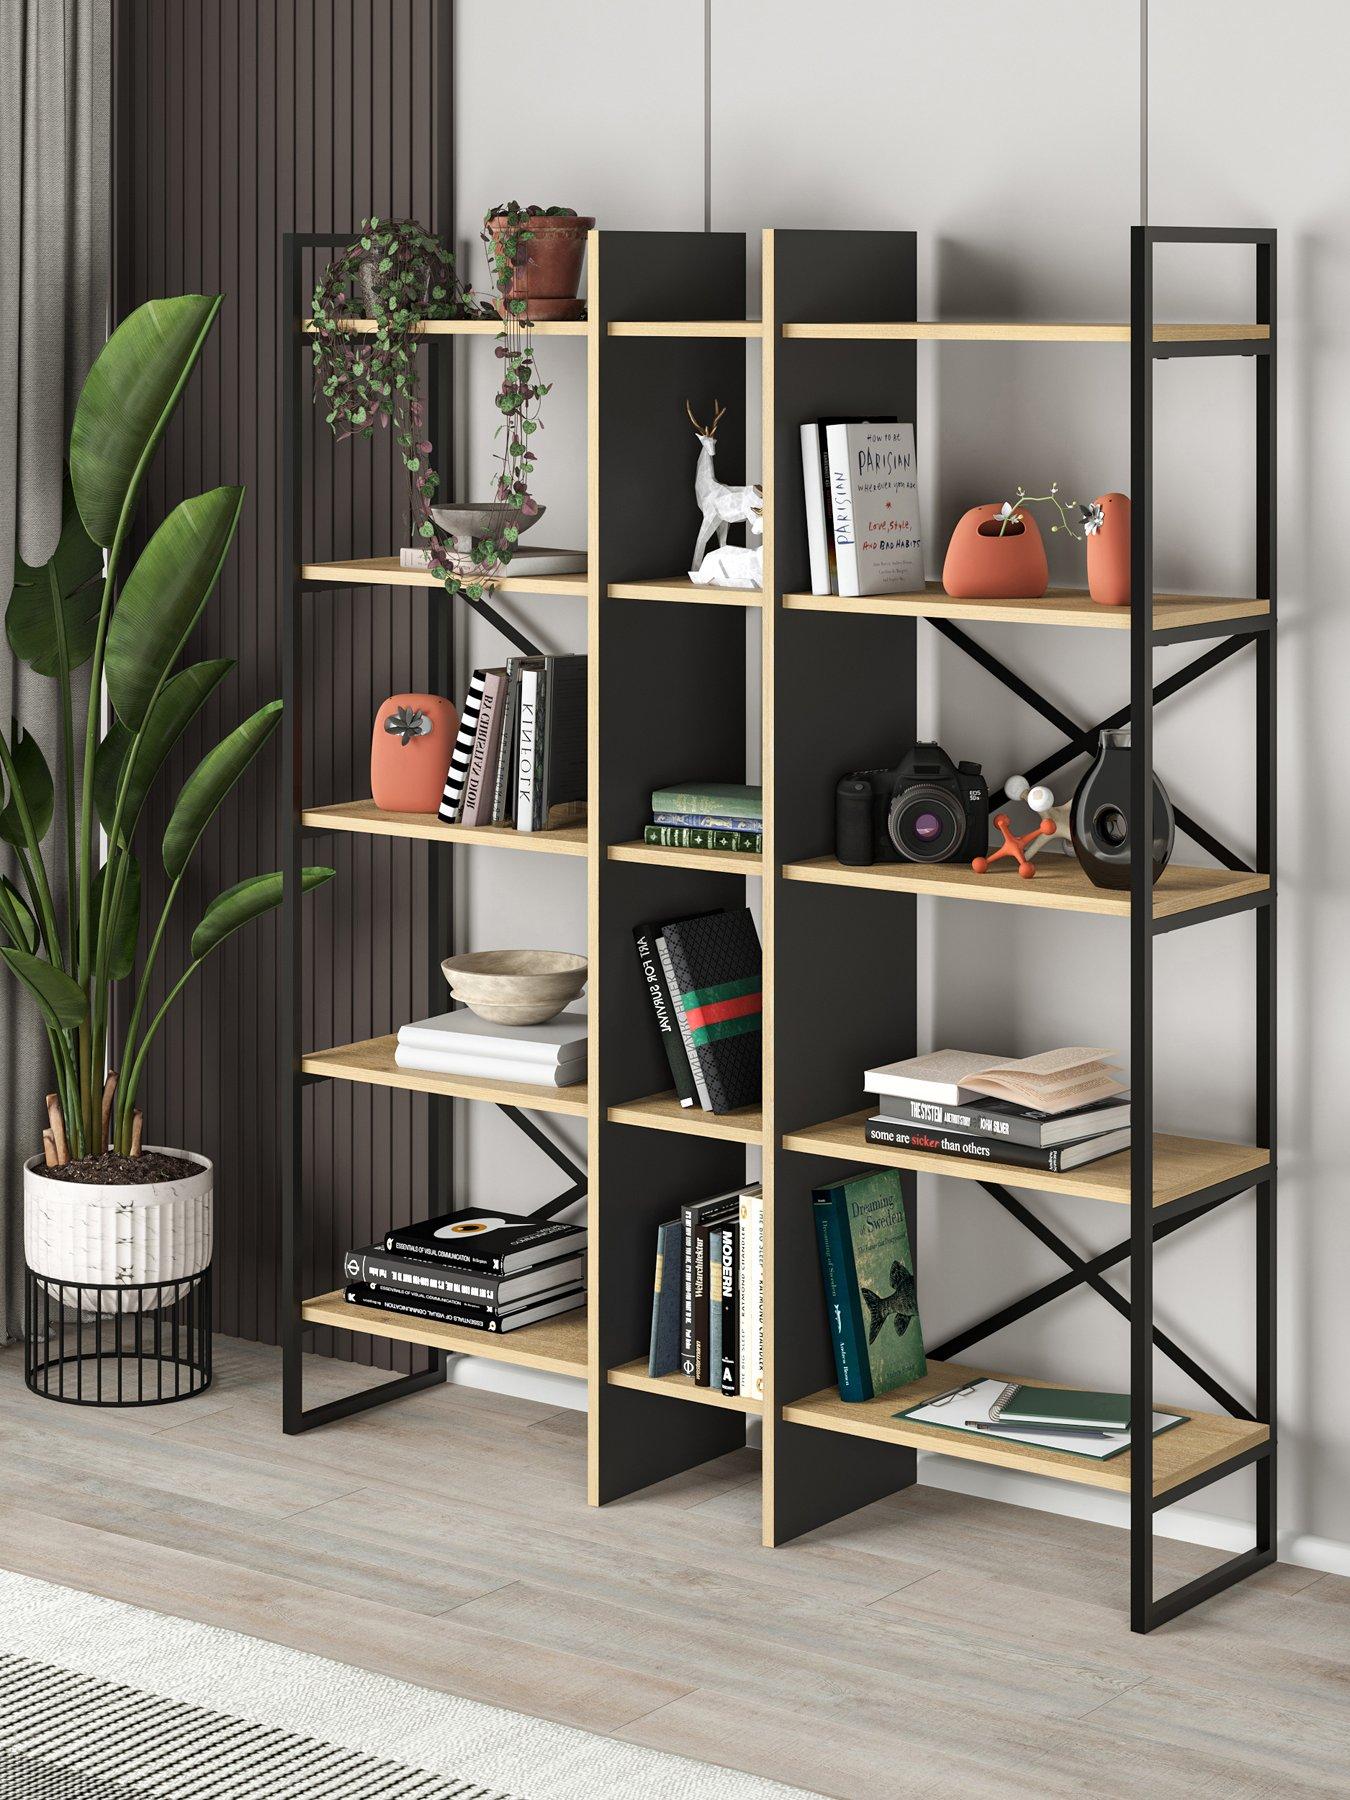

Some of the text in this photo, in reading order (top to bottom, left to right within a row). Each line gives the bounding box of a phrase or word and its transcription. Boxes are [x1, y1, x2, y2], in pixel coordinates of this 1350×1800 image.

[858, 446, 911, 476] PARISIAN
[835, 472, 854, 545] PARISIAN
[879, 540, 894, 550] BAD
[896, 539, 921, 549] HABITS
[910, 1101, 921, 1118] THE
[920, 1102, 943, 1123] SYSTEM
[980, 1117, 993, 1132] JOHN
[993, 1119, 1010, 1135] SILVER
[870, 1129, 990, 1156] some are sicker than others
[851, 1194, 895, 1218] Dreaming
[866, 1209, 904, 1233] Sweden
[395, 1242, 419, 1253] ESSENTIALS
[424, 1247, 437, 1257] VISUAL
[437, 1249, 471, 1263] COMMUNICATION
[721, 1230, 733, 1298] MODERN
[695, 1237, 704, 1298] Weltarchitektur
[384, 1301, 427, 1316] COMMUNICATION
[427, 1310, 445, 1319] VISUAL
[453, 1315, 484, 1327] ESSENTIALS
[722, 1366, 733, 1382] A
